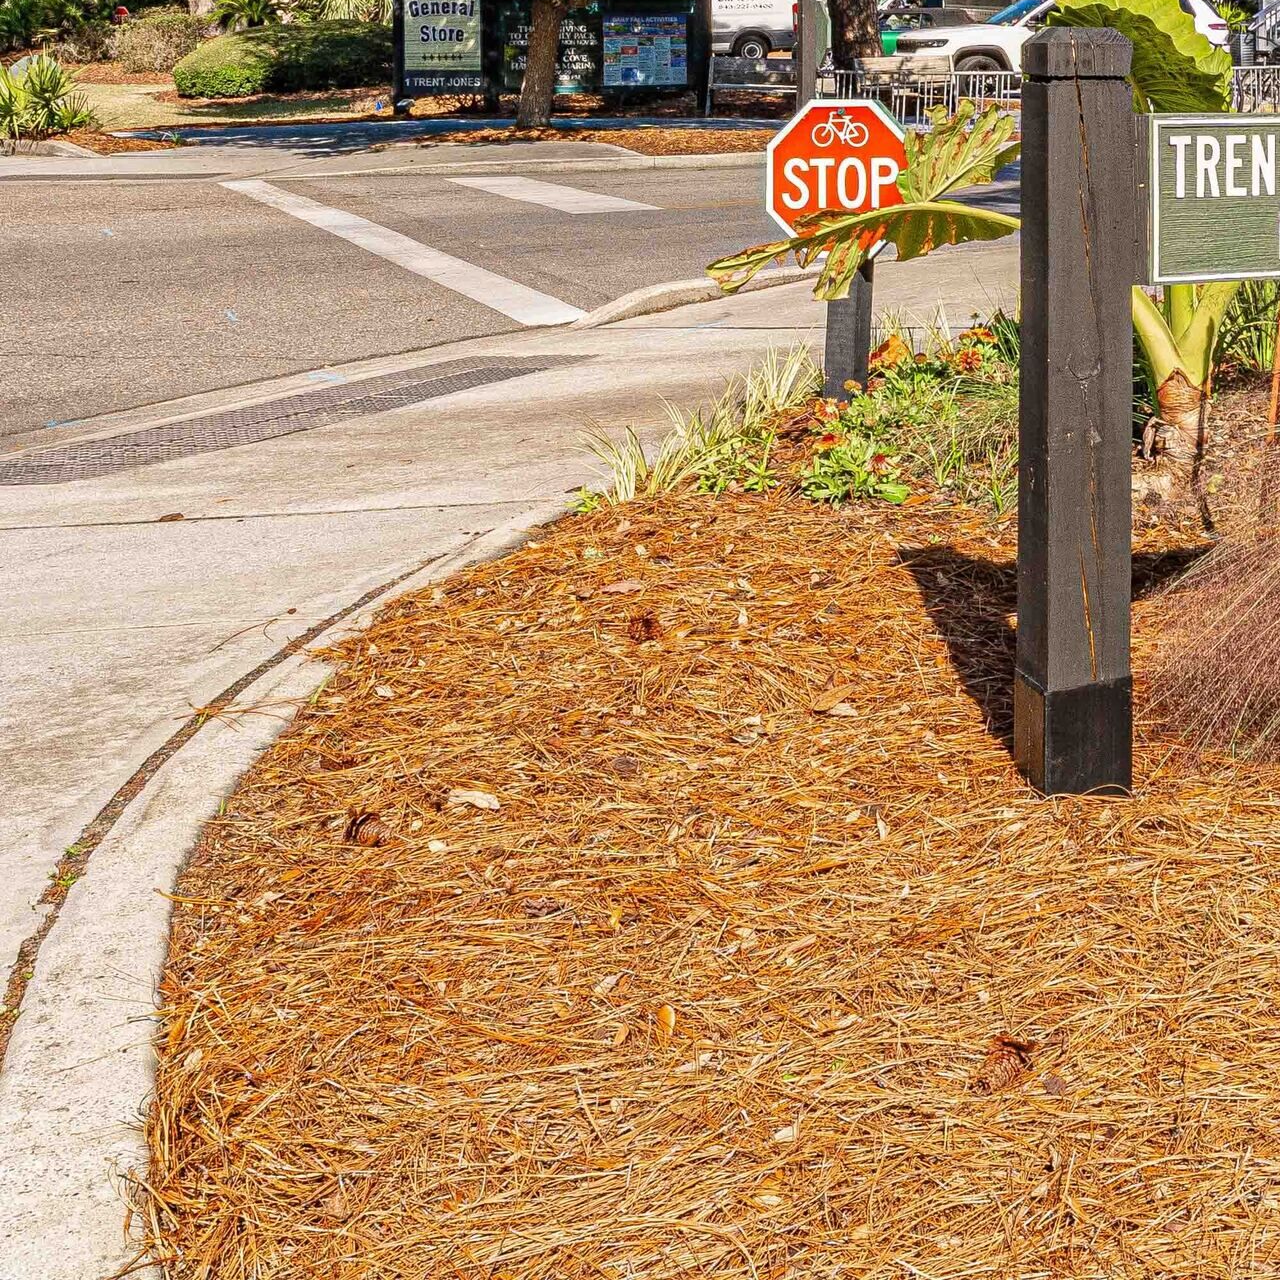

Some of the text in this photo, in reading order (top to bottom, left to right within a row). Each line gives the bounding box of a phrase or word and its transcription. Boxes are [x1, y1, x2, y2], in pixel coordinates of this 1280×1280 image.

[408, 0, 475, 18] General
[420, 25, 465, 42] Store
[404, 77, 481, 87] 1 TRENT JONES
[781, 156, 899, 209] STOP
